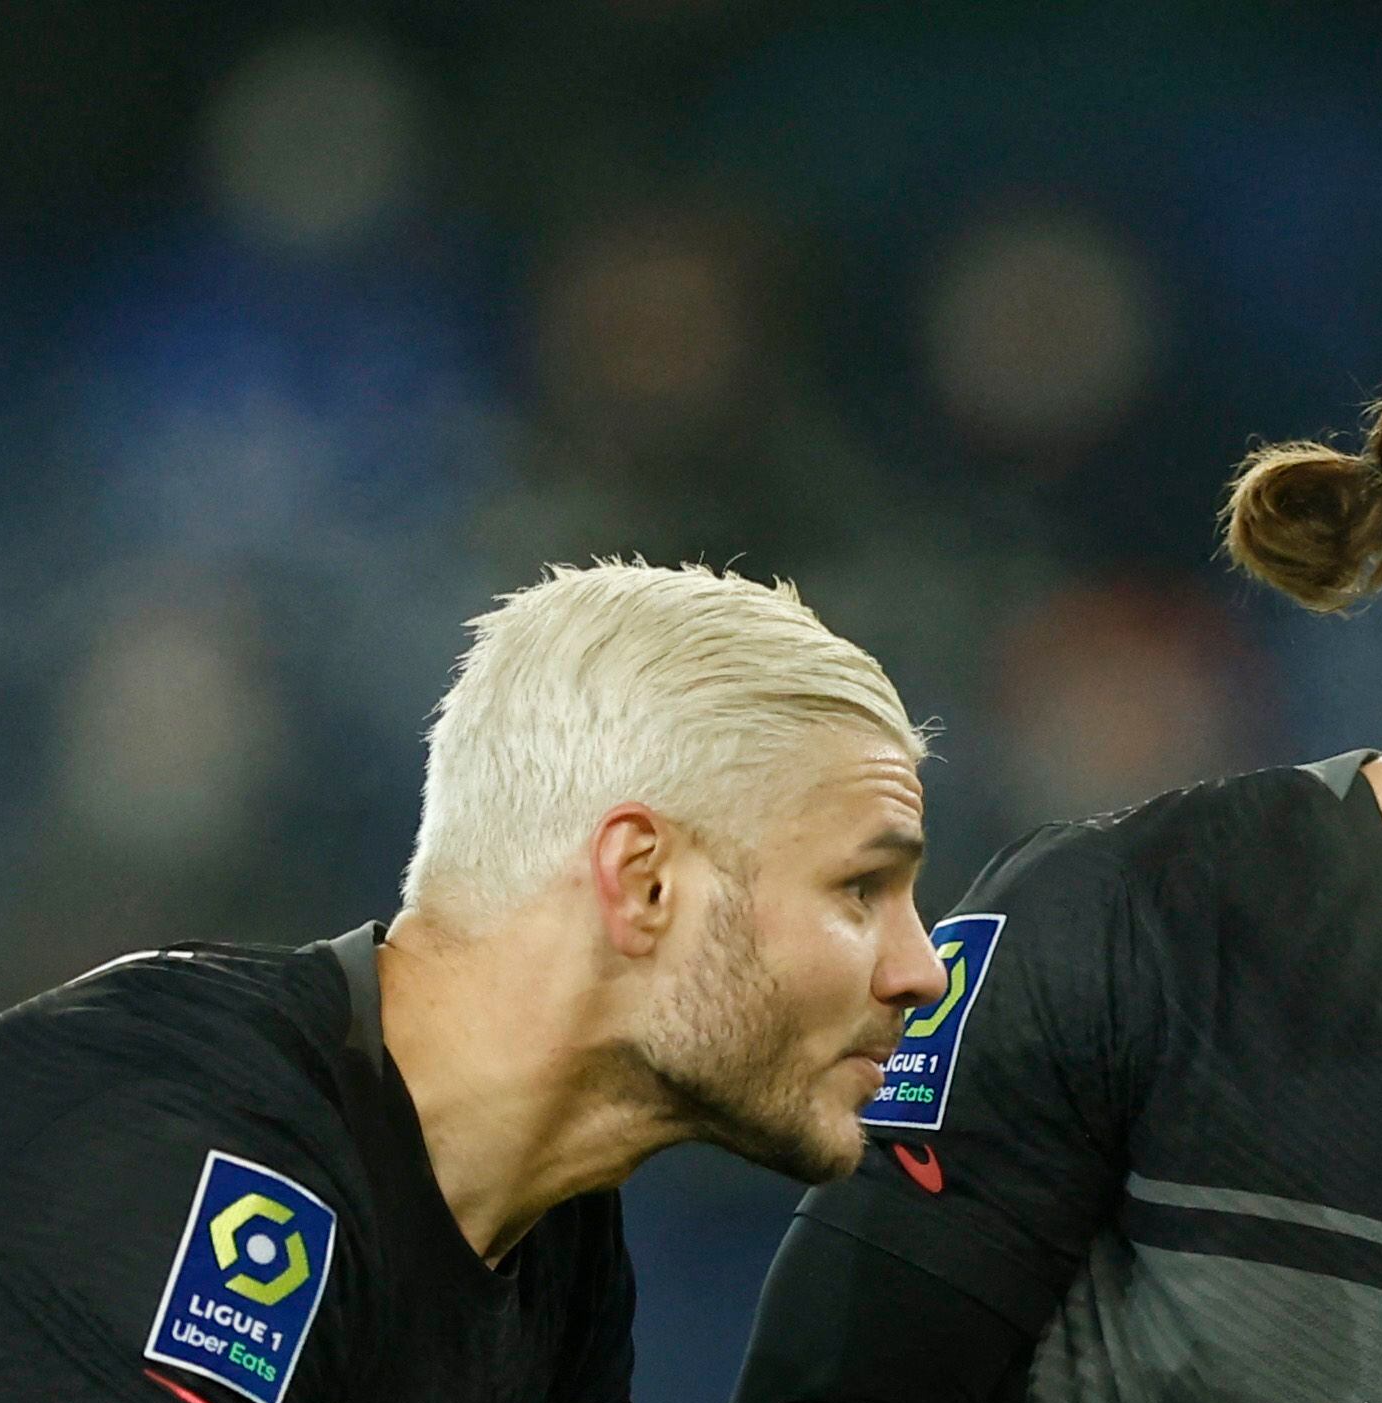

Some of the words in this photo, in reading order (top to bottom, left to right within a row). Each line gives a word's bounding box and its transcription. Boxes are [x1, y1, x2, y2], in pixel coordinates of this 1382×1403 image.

[929, 1055, 939, 1074] 1
[896, 1081, 935, 1104] Eats
[188, 1294, 268, 1344] LIGUE
[271, 1332, 283, 1352] 1
[172, 1318, 229, 1356] Uber
[228, 1341, 277, 1382] Eats
